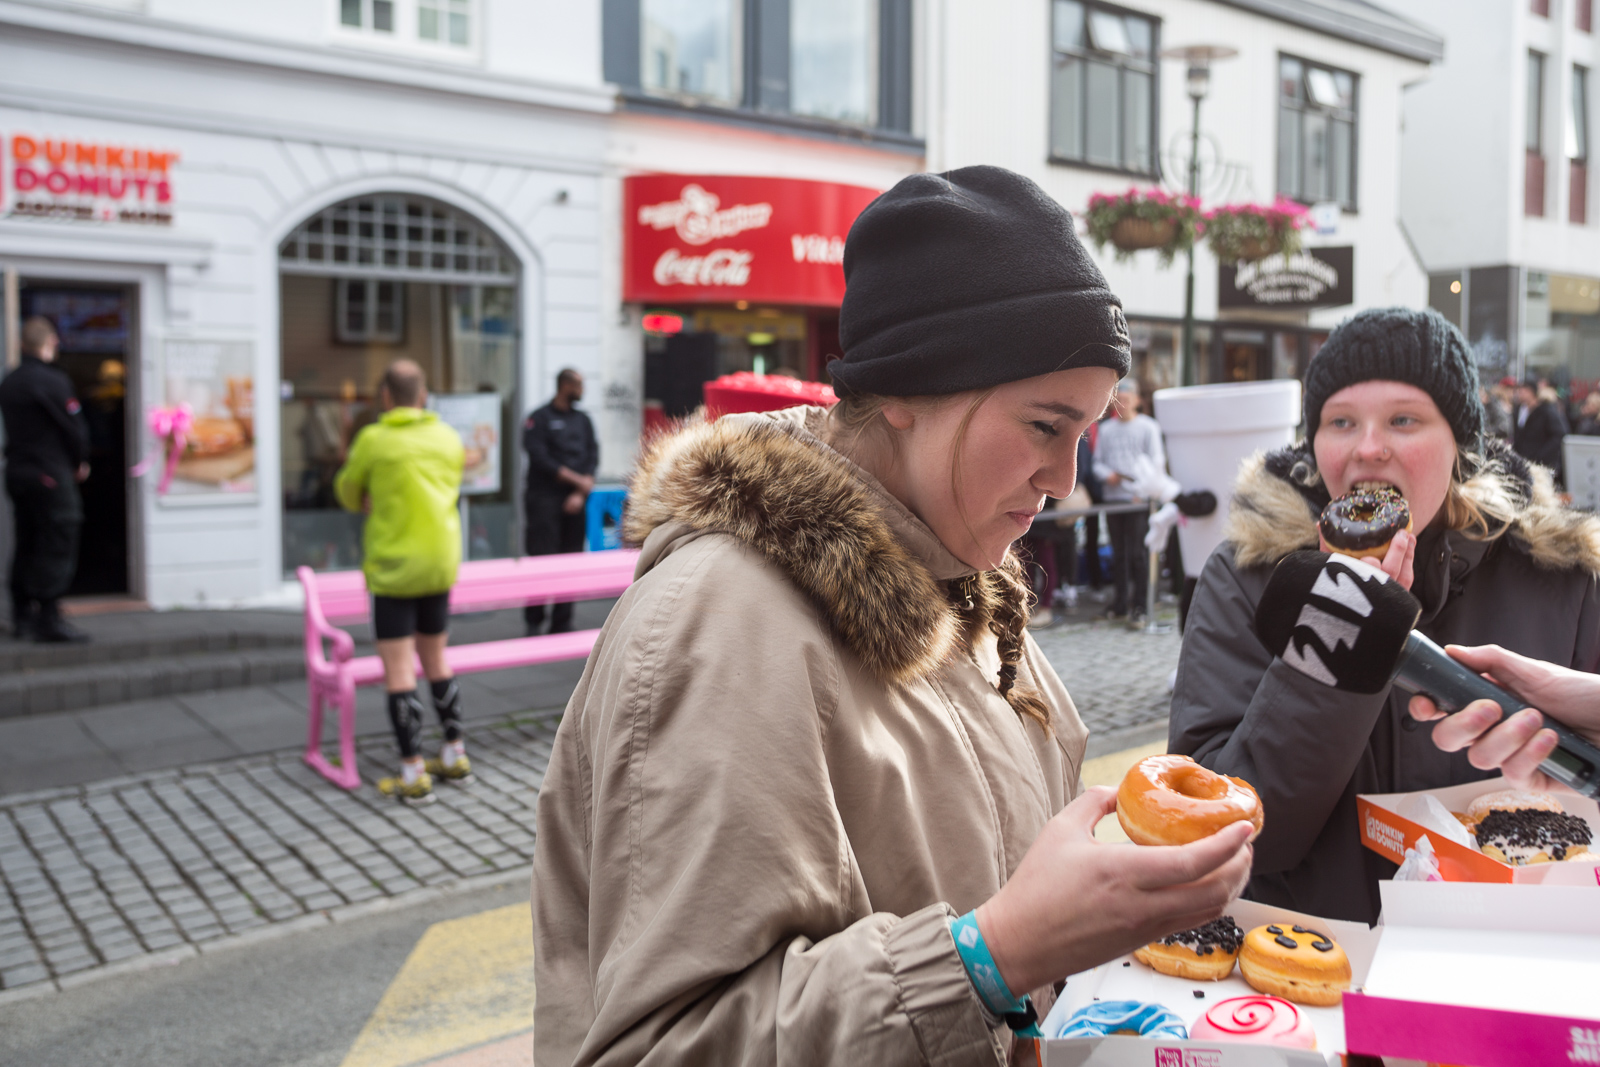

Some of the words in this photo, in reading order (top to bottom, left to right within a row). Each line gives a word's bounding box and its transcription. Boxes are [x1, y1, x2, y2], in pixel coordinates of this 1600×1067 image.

[12, 134, 179, 171] DUNKIN'
[15, 167, 171, 202] DONUTS
[1375, 818, 1405, 844] DUNKIN'
[1376, 831, 1405, 857] DONUTS
